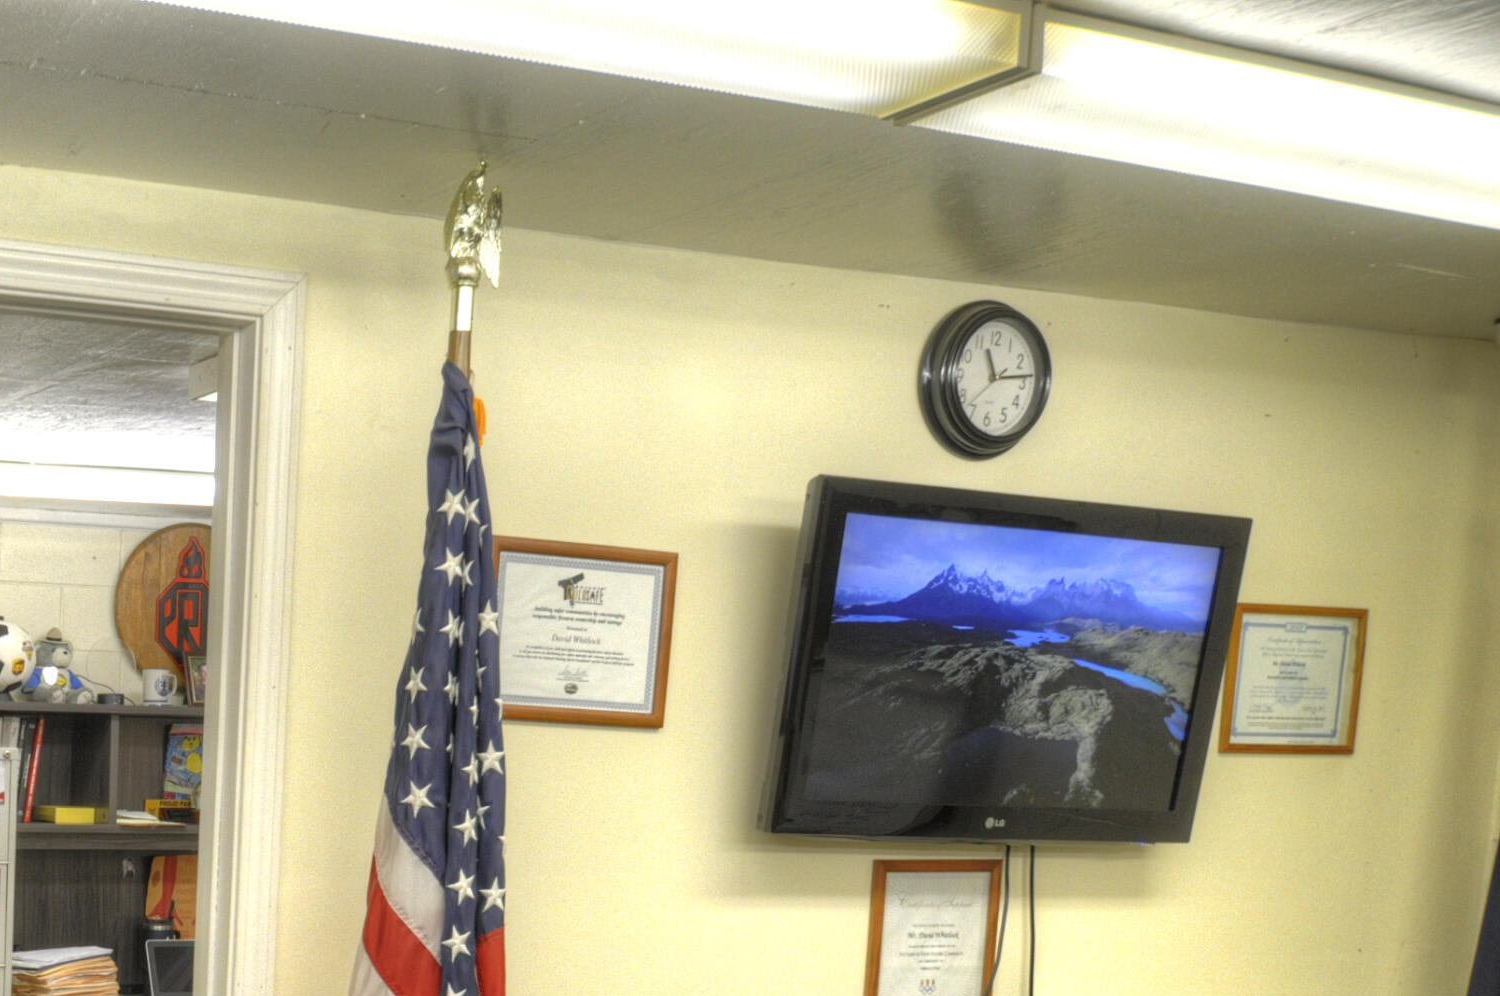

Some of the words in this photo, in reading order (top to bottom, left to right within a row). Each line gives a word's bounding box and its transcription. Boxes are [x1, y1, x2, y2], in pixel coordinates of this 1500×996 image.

[975, 333, 984, 350] 11
[990, 331, 1002, 347] 12
[1016, 353, 1025, 370] 2
[1018, 377, 1027, 391] 3
[1011, 394, 1020, 409] 4
[967, 404, 978, 419] 7
[982, 411, 991, 428] 6
[999, 407, 1008, 424] 5
[994, 819, 1006, 827] LG
